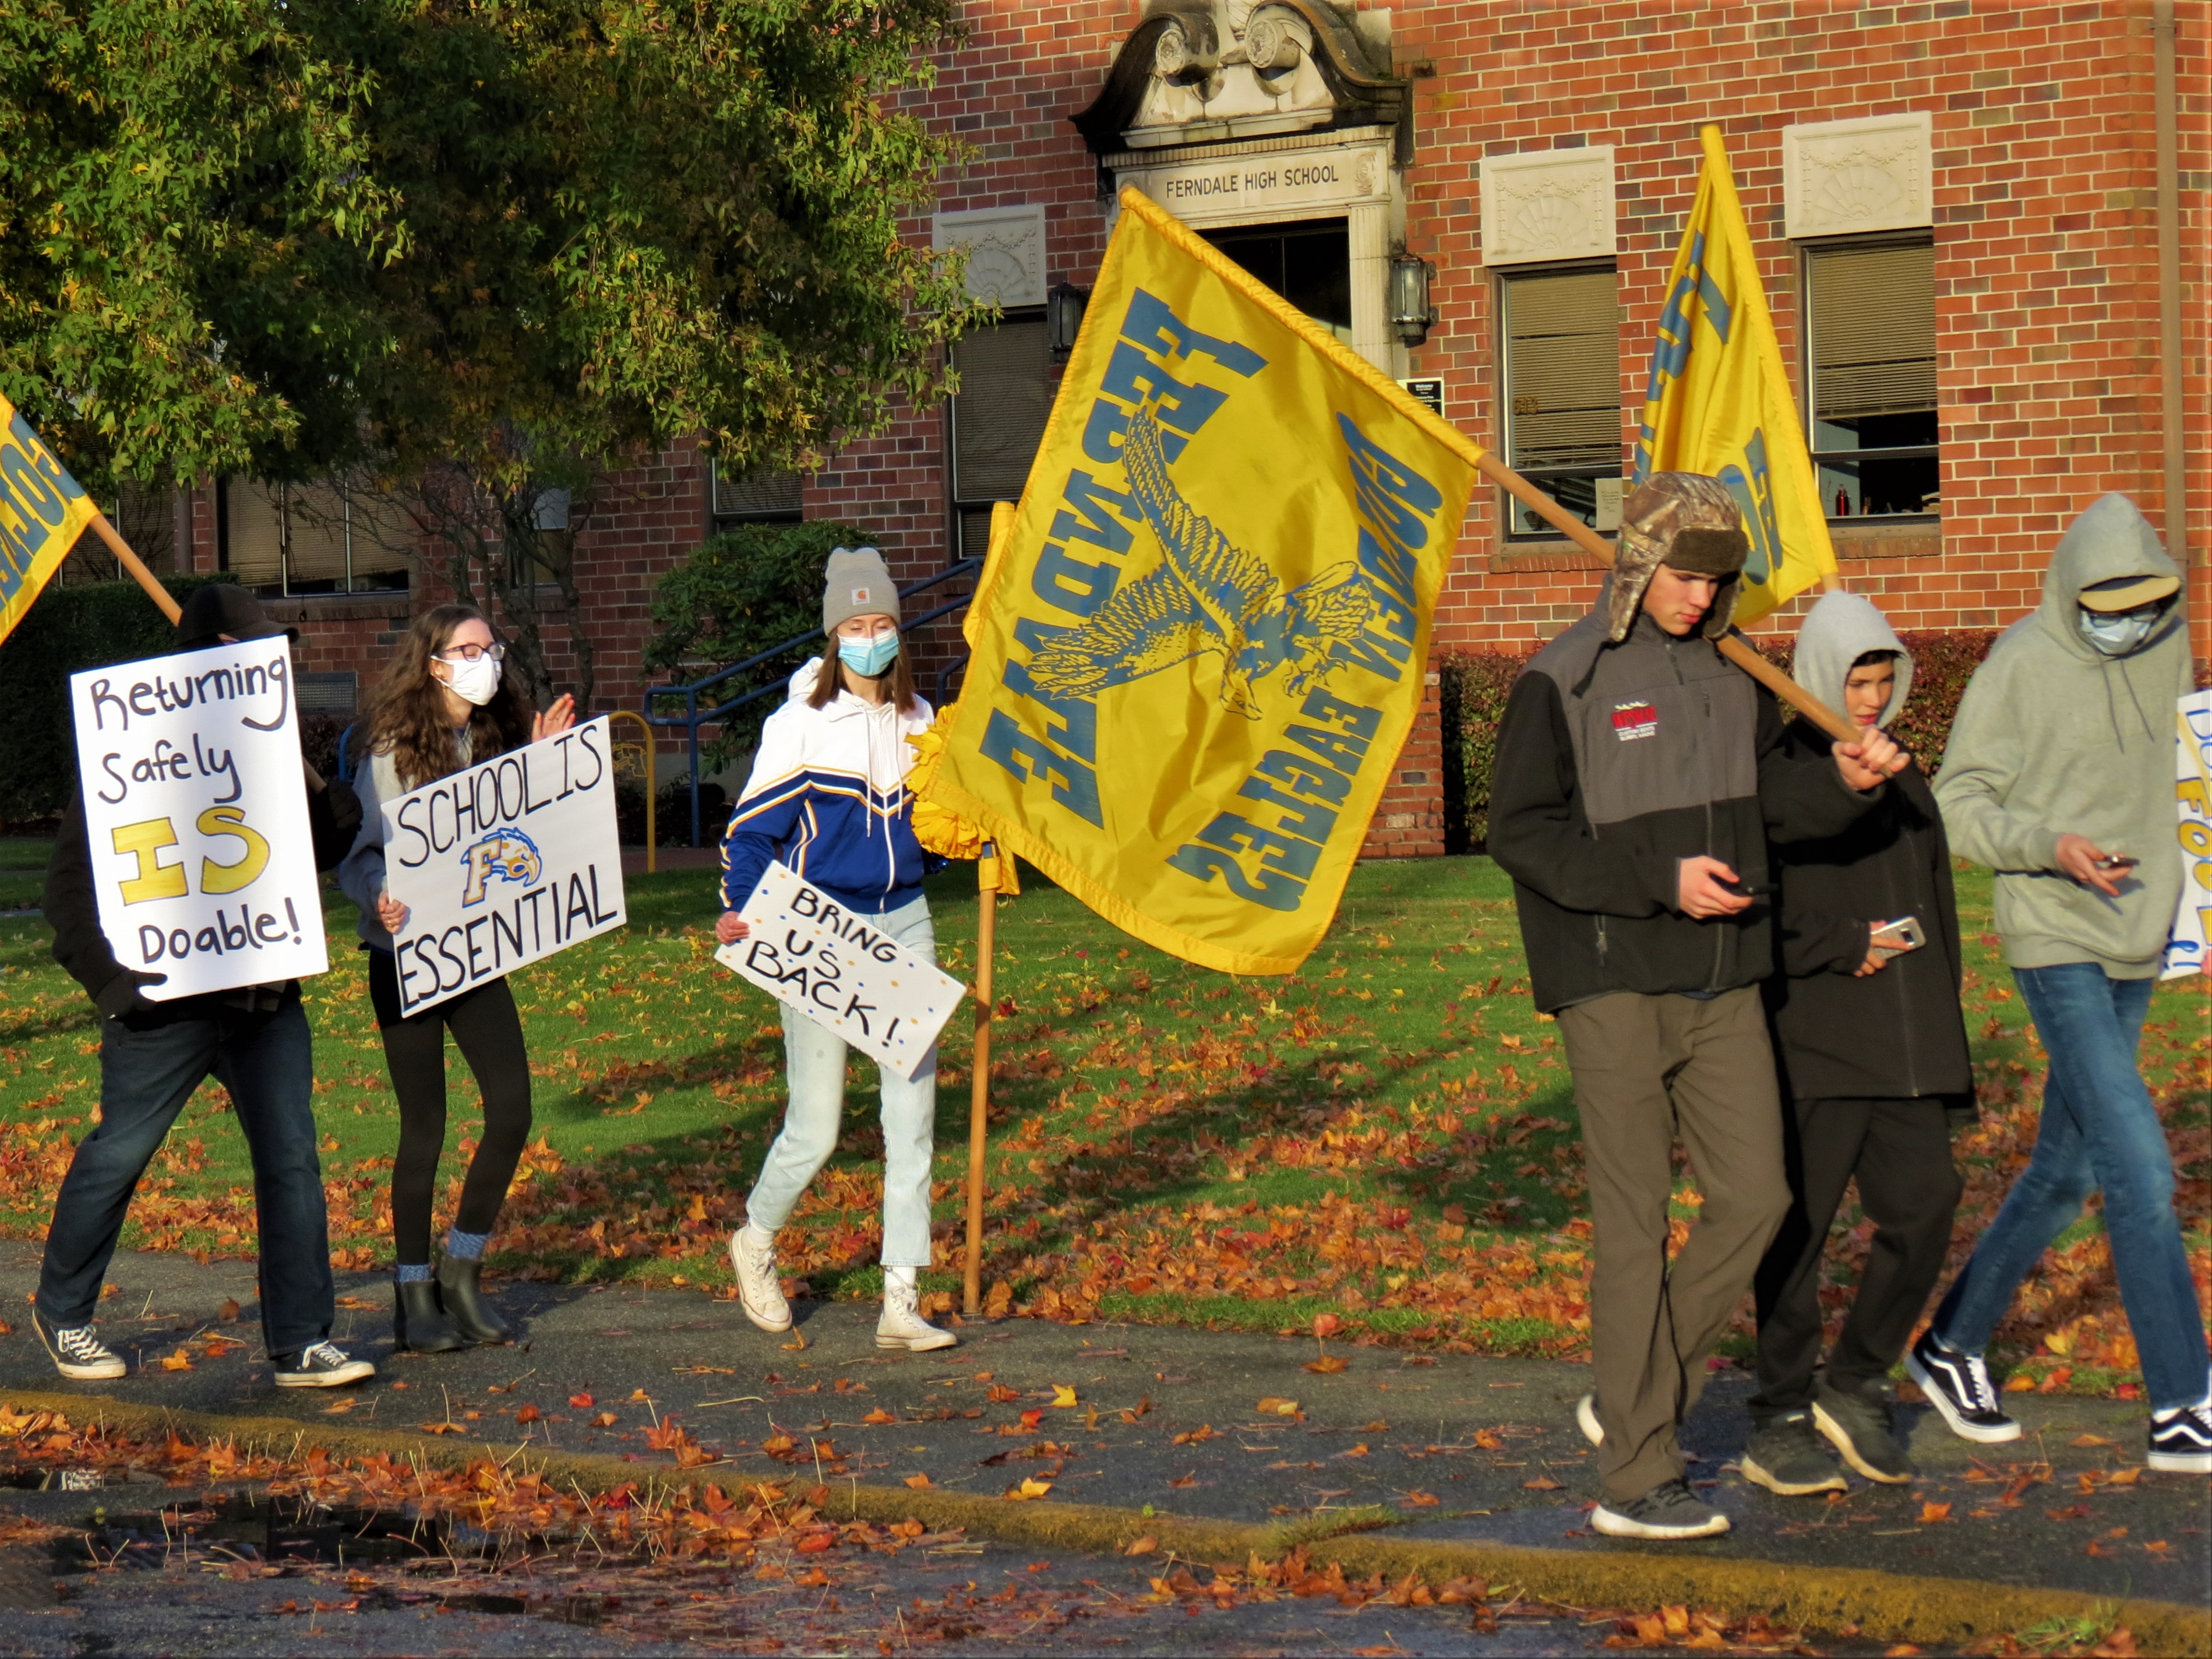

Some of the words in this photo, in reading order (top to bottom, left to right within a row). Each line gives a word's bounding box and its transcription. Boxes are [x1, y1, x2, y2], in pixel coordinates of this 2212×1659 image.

[1166, 175, 1239, 198] FERNDALE
[1245, 171, 1277, 191] HIGH
[1284, 165, 1339, 186] SCHOOL
[90, 656, 288, 731] Returning
[98, 733, 242, 804] Safely
[397, 752, 552, 868] SCHOOL
[553, 724, 602, 802] IS
[111, 806, 271, 906] IS
[139, 897, 302, 964] Doable!
[396, 864, 618, 1012] ESSENTIAL
[785, 929, 842, 980] US
[791, 887, 898, 963] BRING
[746, 941, 901, 1048] BACK!
